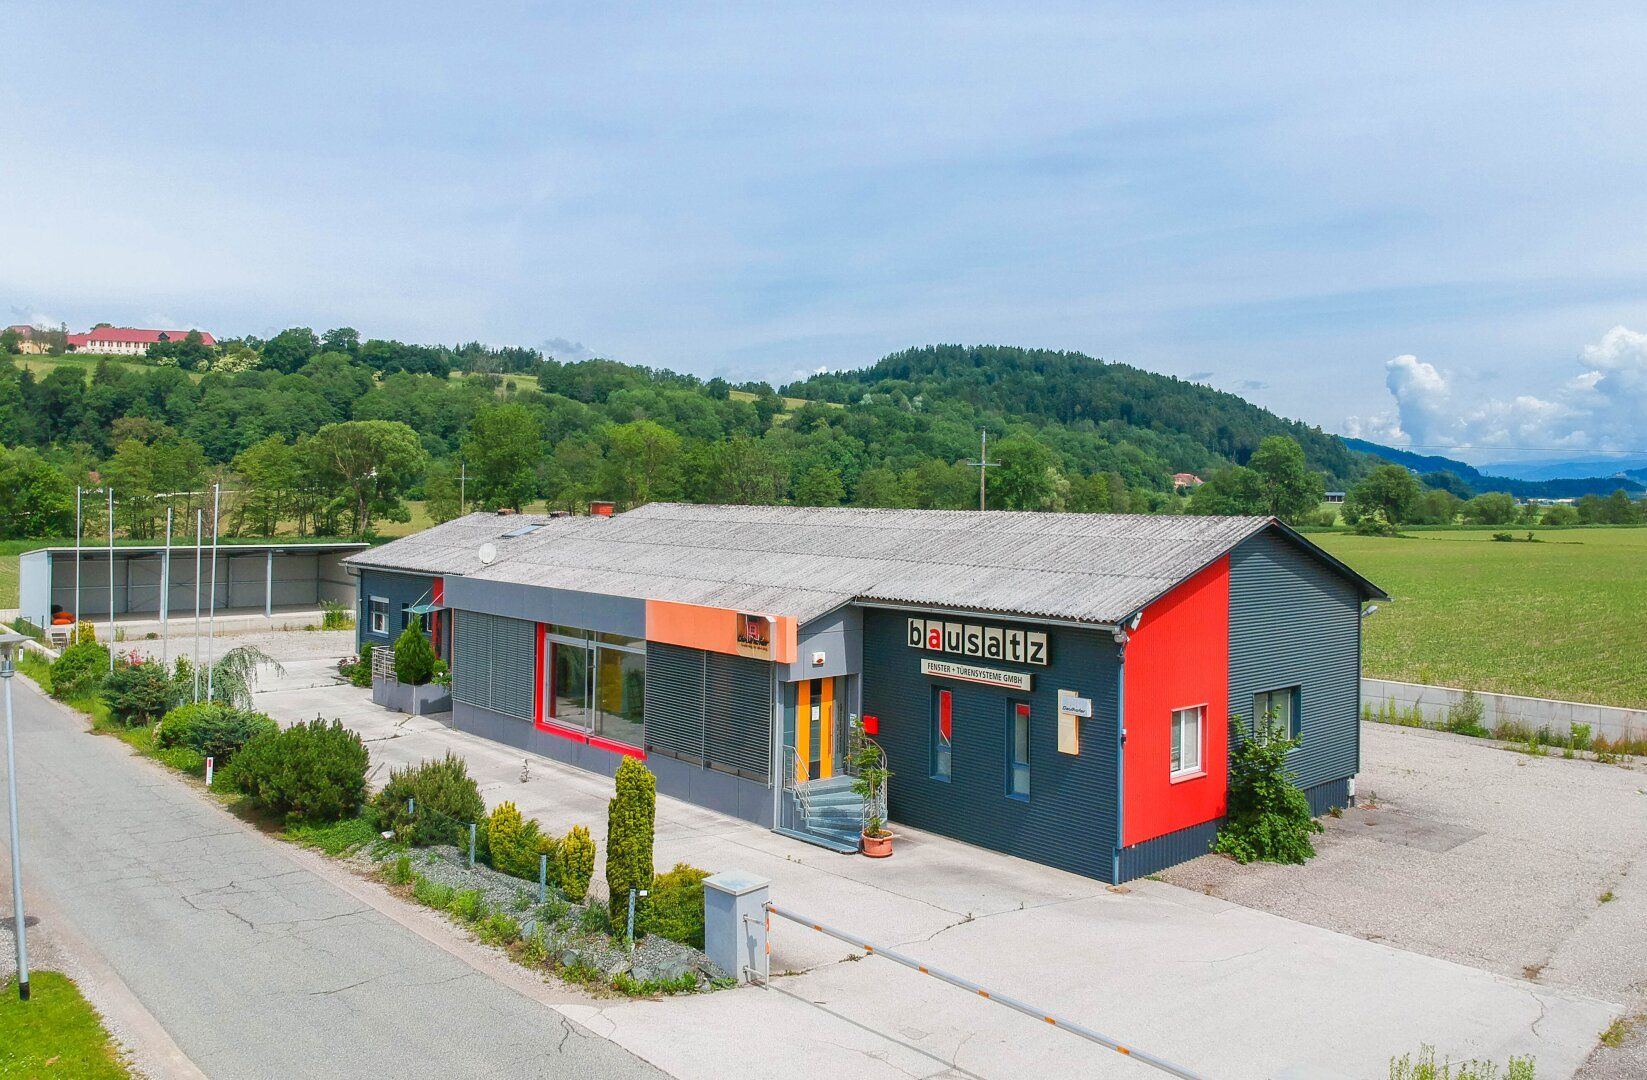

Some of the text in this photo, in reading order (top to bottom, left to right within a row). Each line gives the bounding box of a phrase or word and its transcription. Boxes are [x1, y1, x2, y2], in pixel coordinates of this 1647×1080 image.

[909, 620, 1044, 663] bausatz
[927, 662, 951, 673] FENSTER
[956, 666, 1002, 681] TÜRENSYSTEME
[1003, 674, 1023, 684] GMBH
